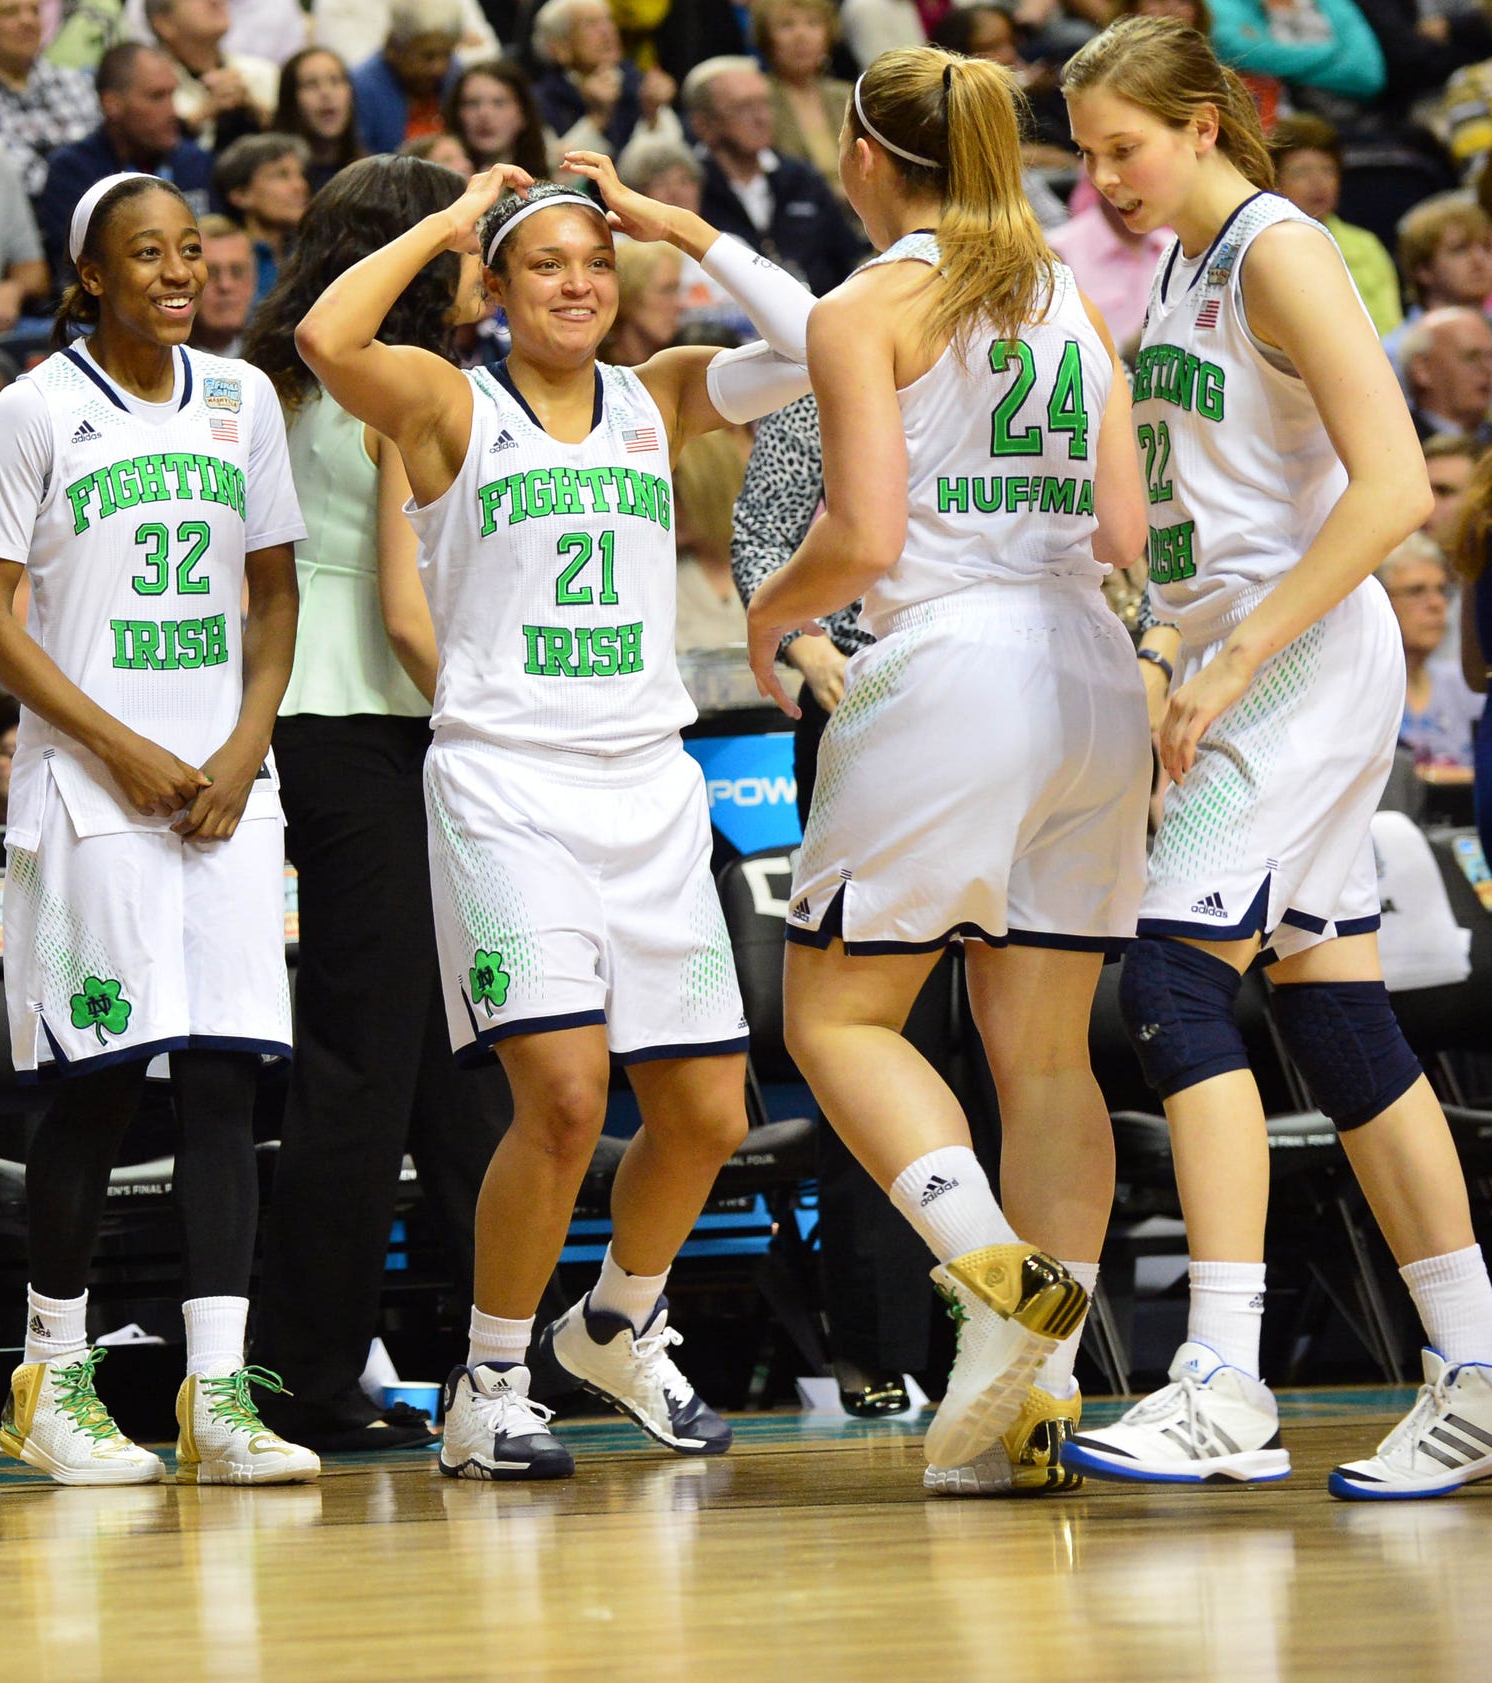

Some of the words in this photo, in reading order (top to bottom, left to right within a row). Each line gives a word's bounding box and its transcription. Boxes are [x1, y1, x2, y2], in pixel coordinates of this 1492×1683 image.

[988, 338, 1088, 461] 24
[71, 431, 102, 444] adidas
[1137, 420, 1173, 504] 22
[66, 452, 247, 536] FIGHTING
[478, 466, 671, 537] FIGHTING
[937, 476, 1095, 518] HUFFMA
[131, 520, 211, 596] 32
[555, 530, 620, 606] 21
[110, 613, 229, 671] IRISH
[522, 621, 645, 678] IRISH
[1191, 903, 1228, 919] adidas
[919, 1178, 960, 1207] adidas
